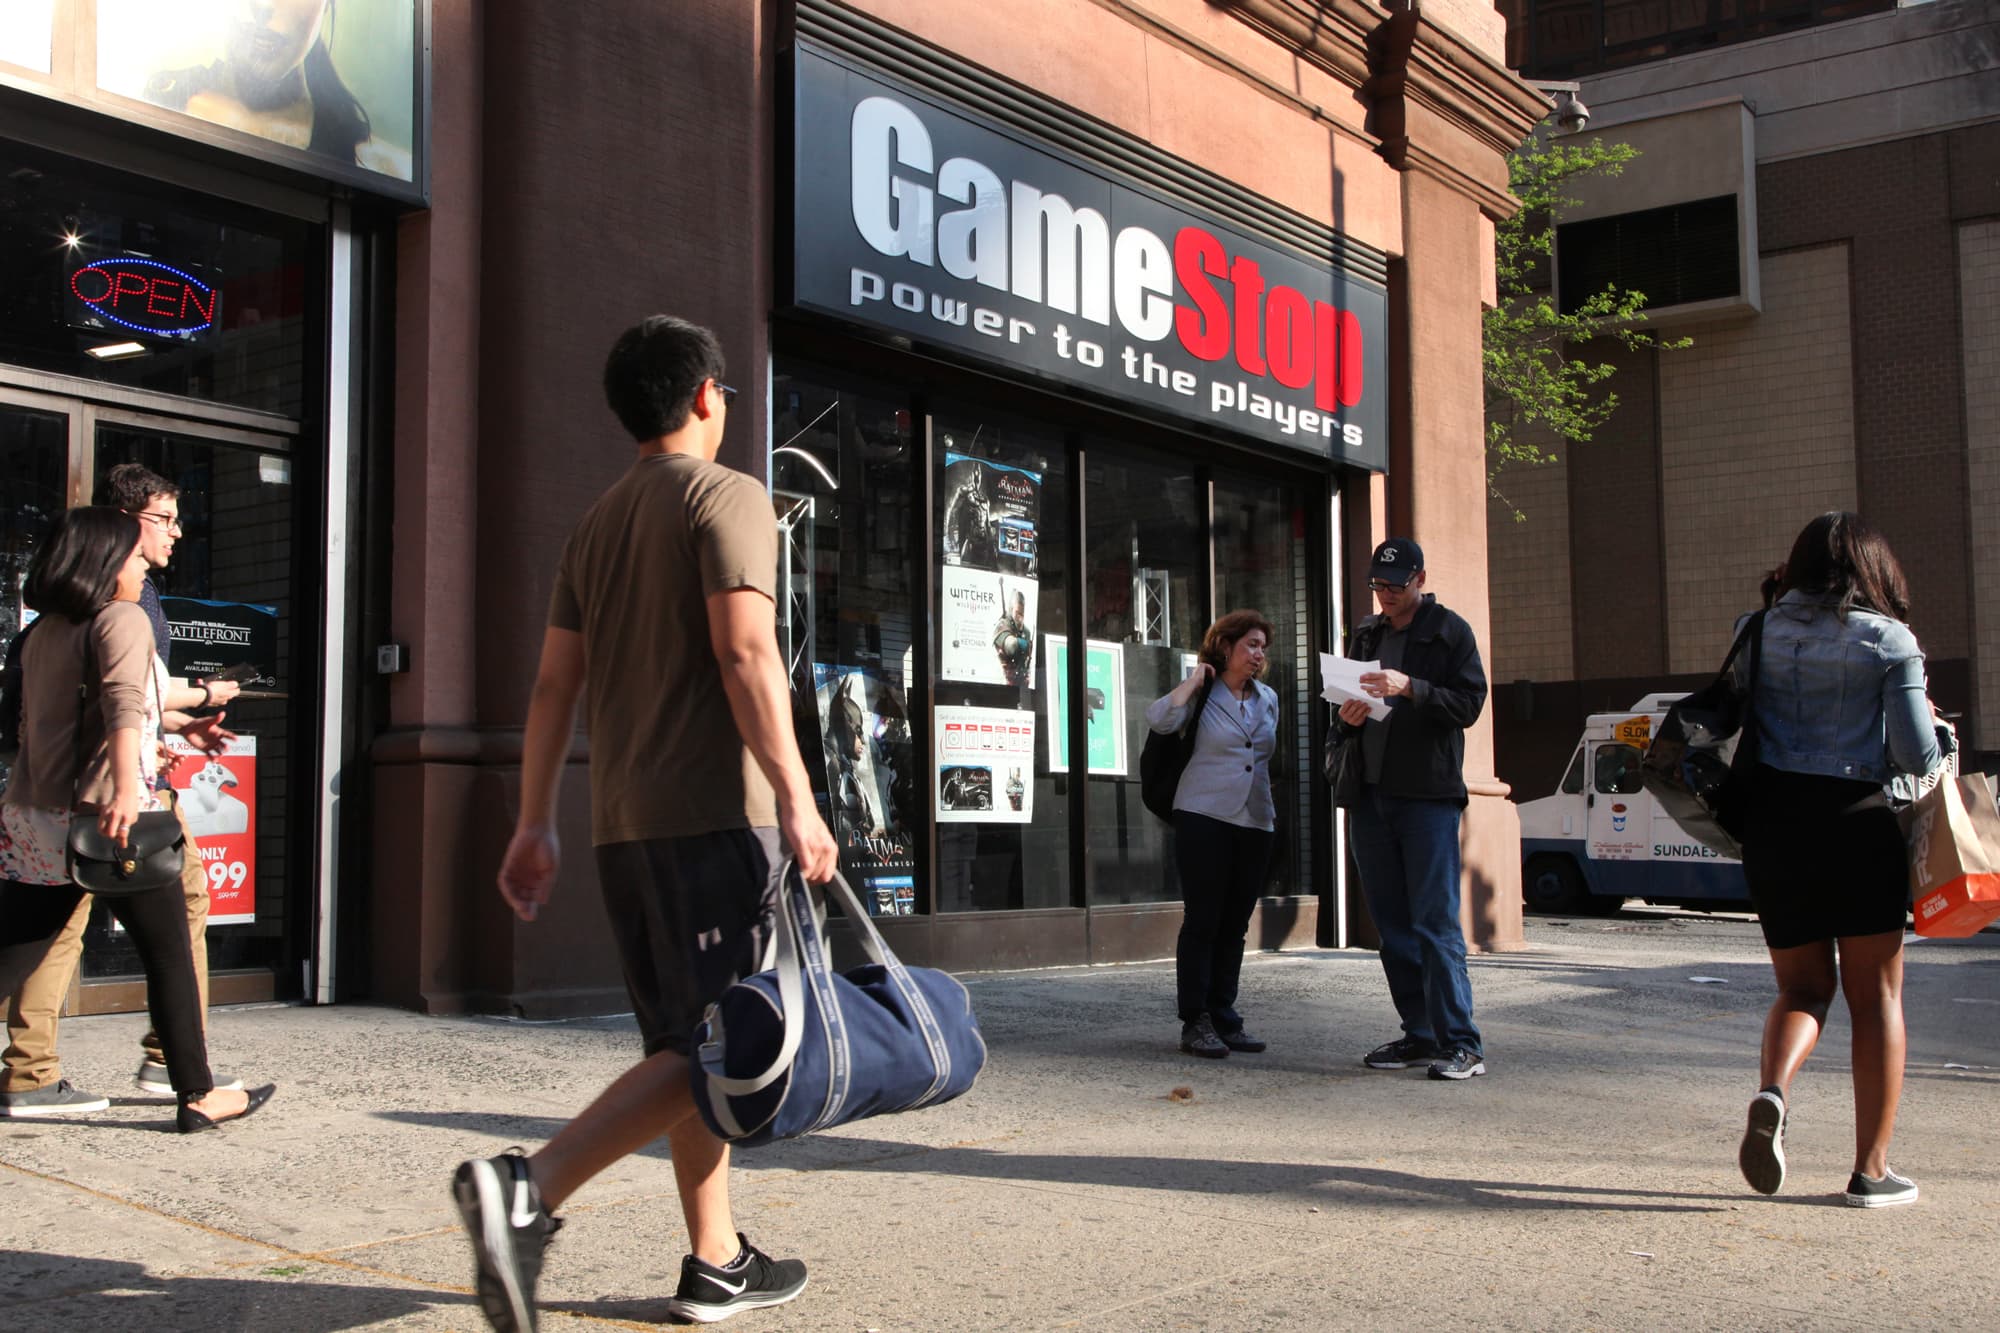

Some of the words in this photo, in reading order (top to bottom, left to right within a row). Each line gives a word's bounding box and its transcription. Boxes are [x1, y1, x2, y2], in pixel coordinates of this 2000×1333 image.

[850, 96, 1364, 413] GameStop
[71, 266, 217, 324] OPEN
[850, 266, 1036, 345] power
[1053, 324, 1105, 368] to
[1121, 338, 1197, 396] the
[1211, 380, 1364, 447] players
[950, 587, 996, 604] WITCHER
[168, 624, 251, 642] BATTLEFRONT
[185, 665, 214, 673] AVAILABLE
[1623, 726, 1650, 738] SLOW
[1653, 844, 1718, 858] SUNDAES
